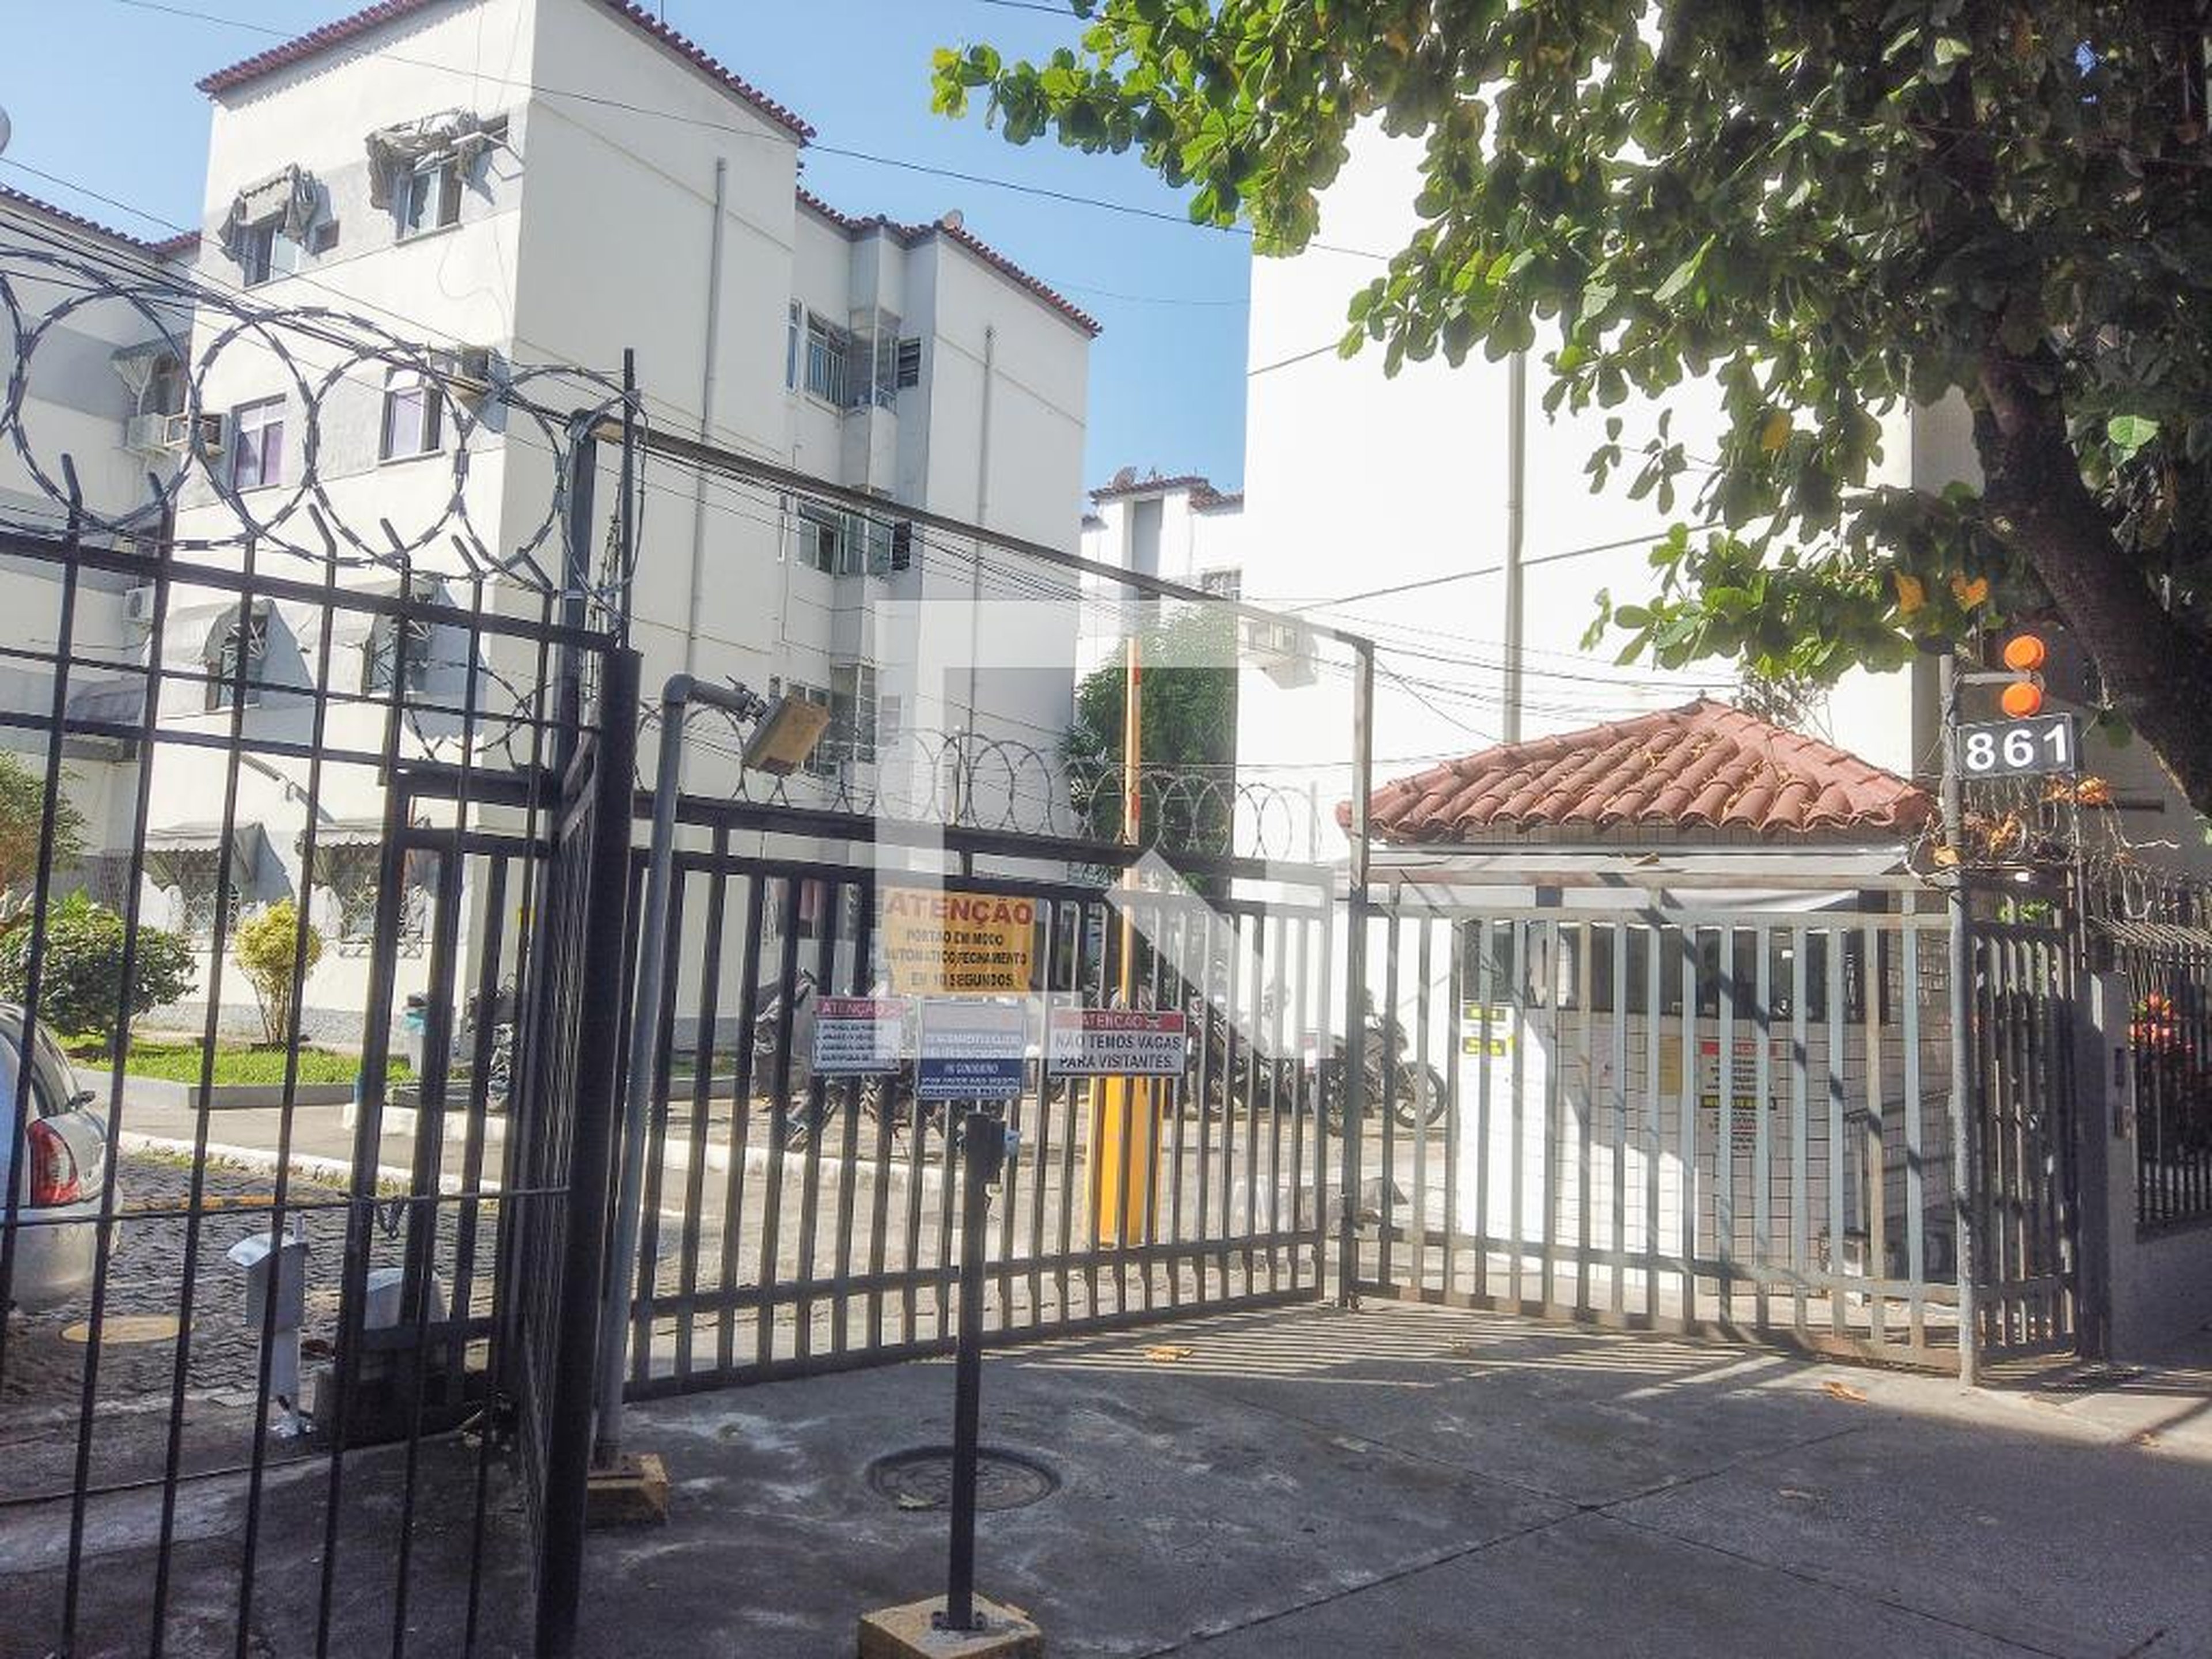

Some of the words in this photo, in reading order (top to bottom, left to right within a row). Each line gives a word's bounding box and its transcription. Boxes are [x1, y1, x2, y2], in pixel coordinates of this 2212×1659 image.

[1966, 724, 2067, 771] 861
[885, 893, 1033, 929] ATENÇÃO
[950, 973, 1014, 987] SEGUNDOS
[1089, 1033, 1134, 1049] TEMOS
[1137, 1035, 1181, 1051] VAGAS
[1059, 1053, 1095, 1068] PARA
